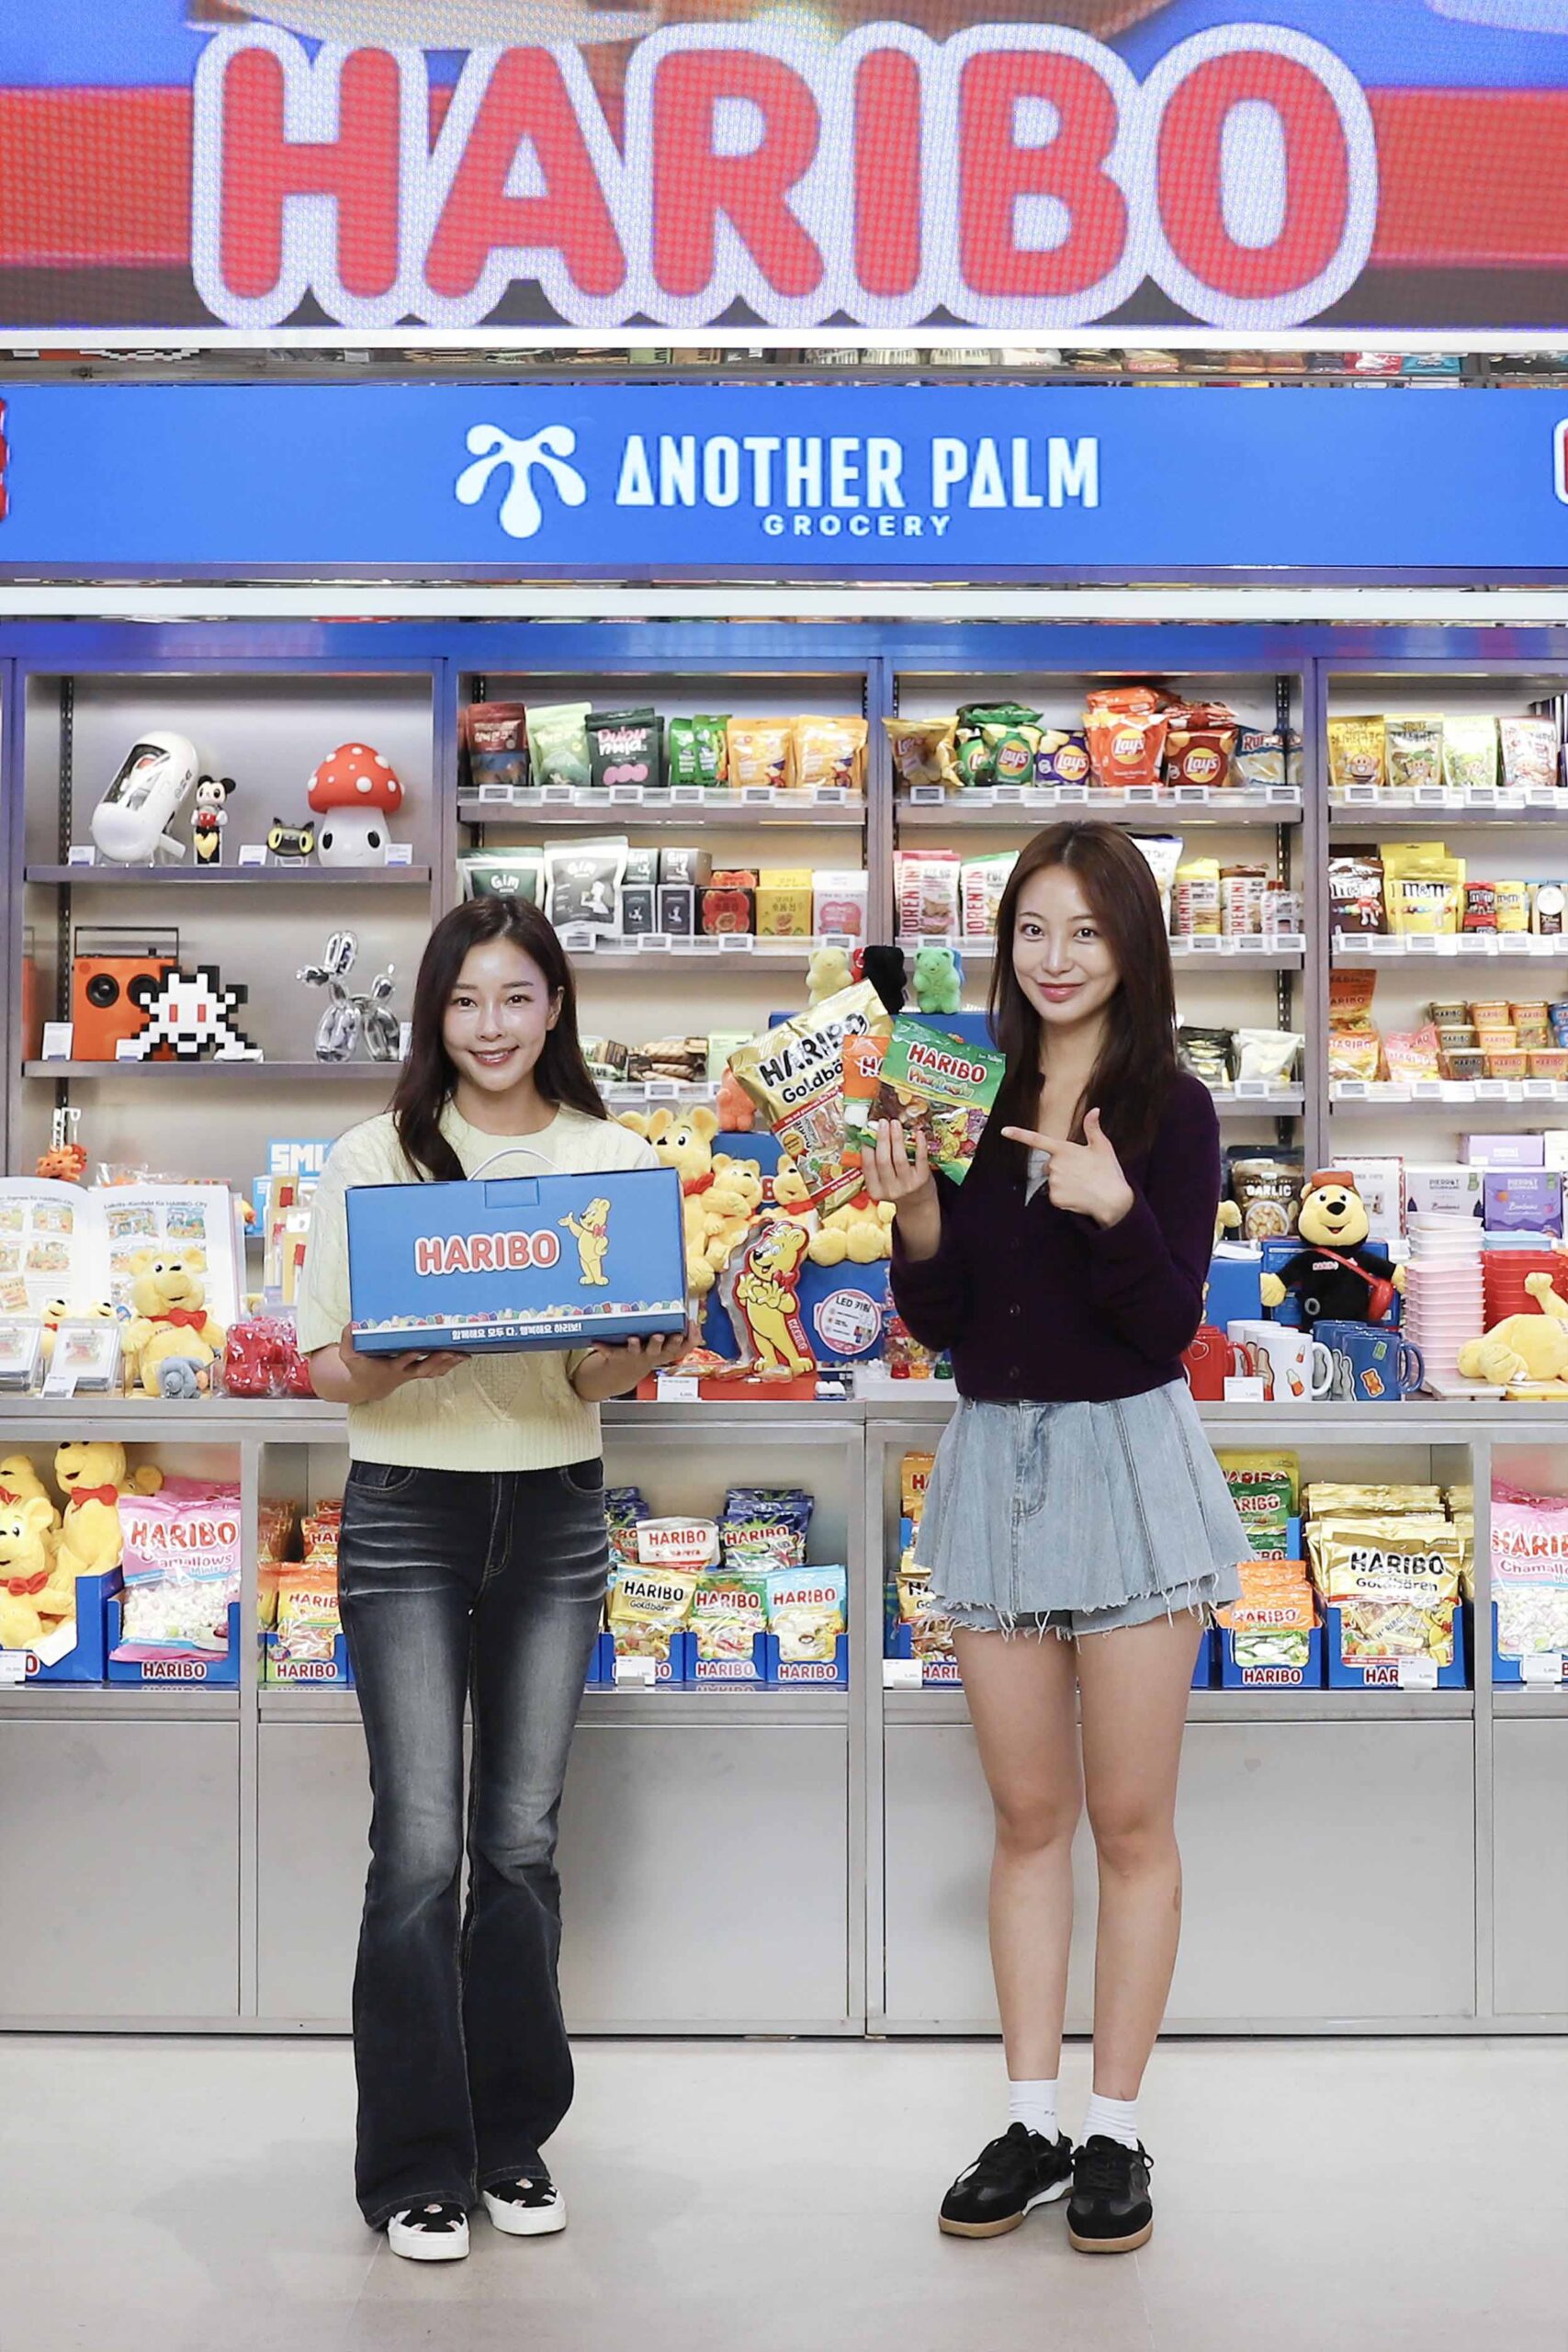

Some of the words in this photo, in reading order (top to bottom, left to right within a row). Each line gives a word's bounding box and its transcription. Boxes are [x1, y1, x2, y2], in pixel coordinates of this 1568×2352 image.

[219, 44, 1350, 300] HARIBO
[615, 435, 906, 508] ANOTHER
[931, 436, 1100, 509] PALM
[762, 514, 951, 537] GROCERY
[1331, 996, 1365, 1005] ARIBO
[908, 1043, 987, 1083] HARIBO
[782, 1058, 843, 1103] Goldbä
[1246, 1184, 1292, 1196] GARLIC
[418, 1233, 558, 1273] HARIBO
[835, 1295, 853, 1307] LED
[488, 1327, 505, 1338] 모두
[554, 1322, 582, 1333] 하리보!
[1235, 1496, 1280, 1511] RIBO
[130, 1521, 237, 1548] HARIBO
[649, 1530, 706, 1545] HARIBO
[726, 1526, 788, 1545] HARIBO
[1492, 1530, 1568, 1557] HARI
[1350, 1552, 1444, 1575] HARIBO
[1500, 1560, 1568, 1574] Chamall
[625, 1580, 683, 1601] HARIBO
[773, 1589, 836, 1605] HARIBO
[289, 1593, 338, 1609] HARIB
[695, 1591, 759, 1609] HARIBO
[142, 1664, 206, 1678] HARIBO
[277, 1665, 336, 1678] HARIBO
[697, 1664, 753, 1677] HARIBO
[780, 1666, 837, 1679] HARIBO
[922, 1664, 962, 1680] HARI
[1245, 1669, 1301, 1682] HARIBO
[1365, 1668, 1398, 1682] HAR
